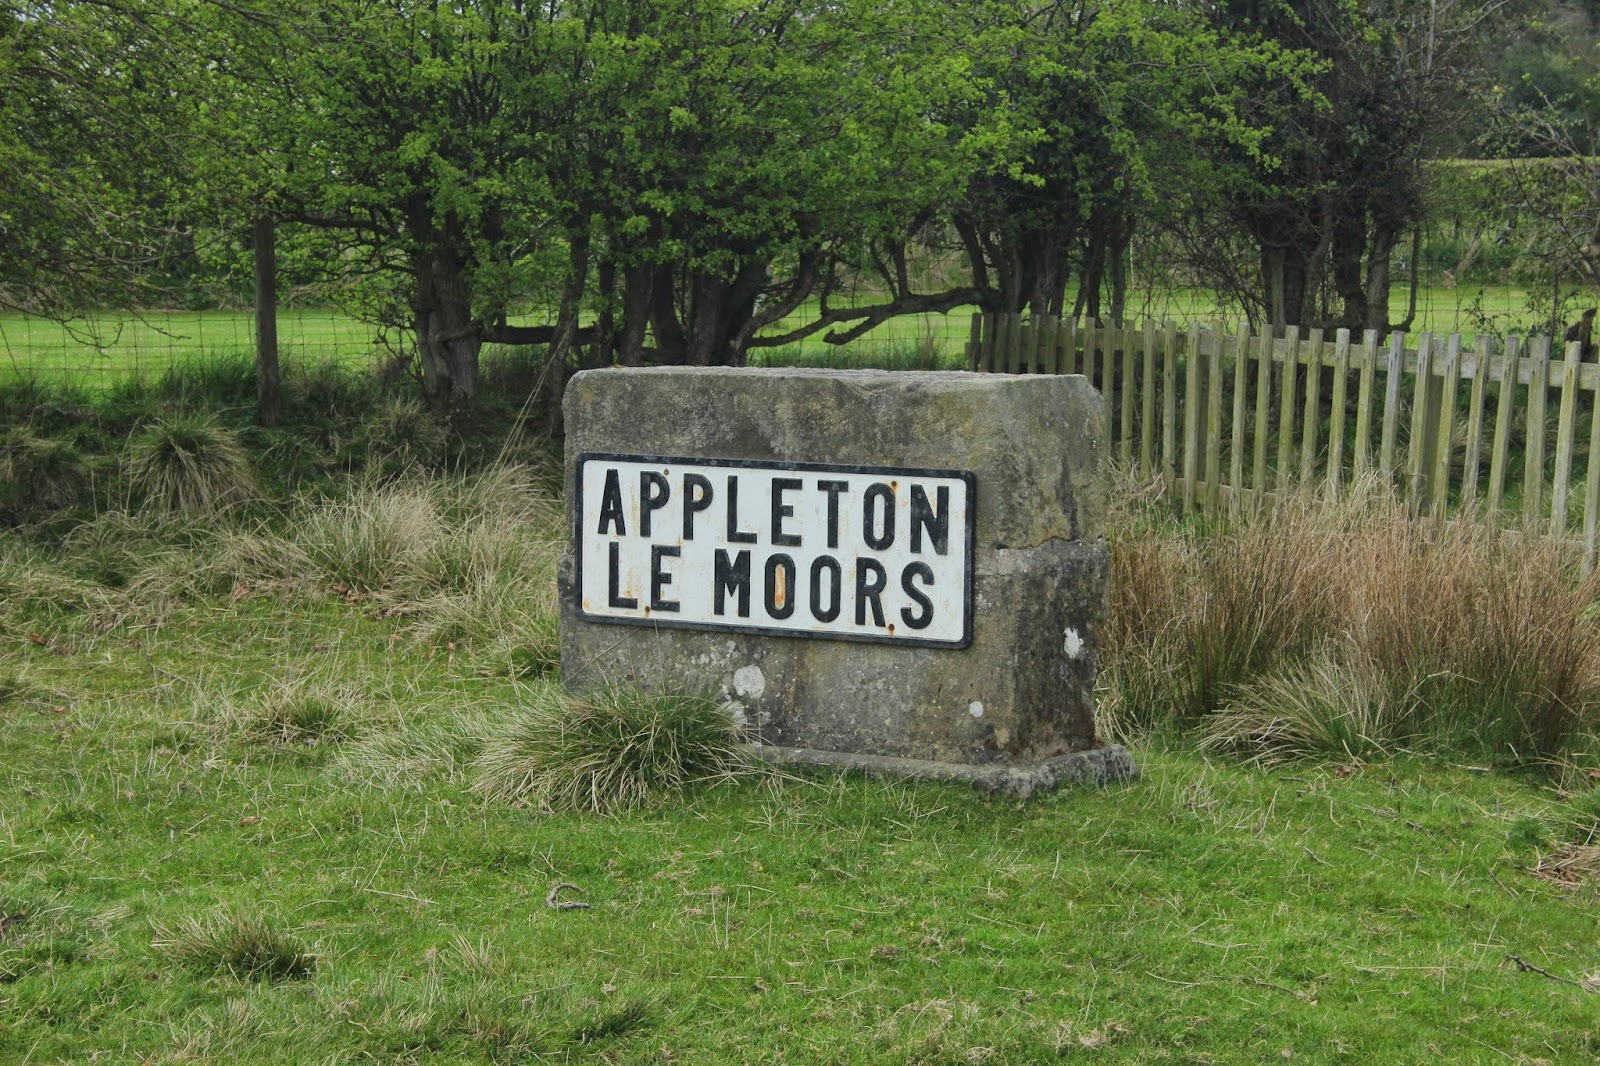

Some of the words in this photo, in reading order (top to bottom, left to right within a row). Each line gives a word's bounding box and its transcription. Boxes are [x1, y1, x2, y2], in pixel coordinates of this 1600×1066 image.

[597, 469, 949, 556] APPLETON
[608, 541, 681, 613] LE
[713, 548, 935, 630] MOORS
